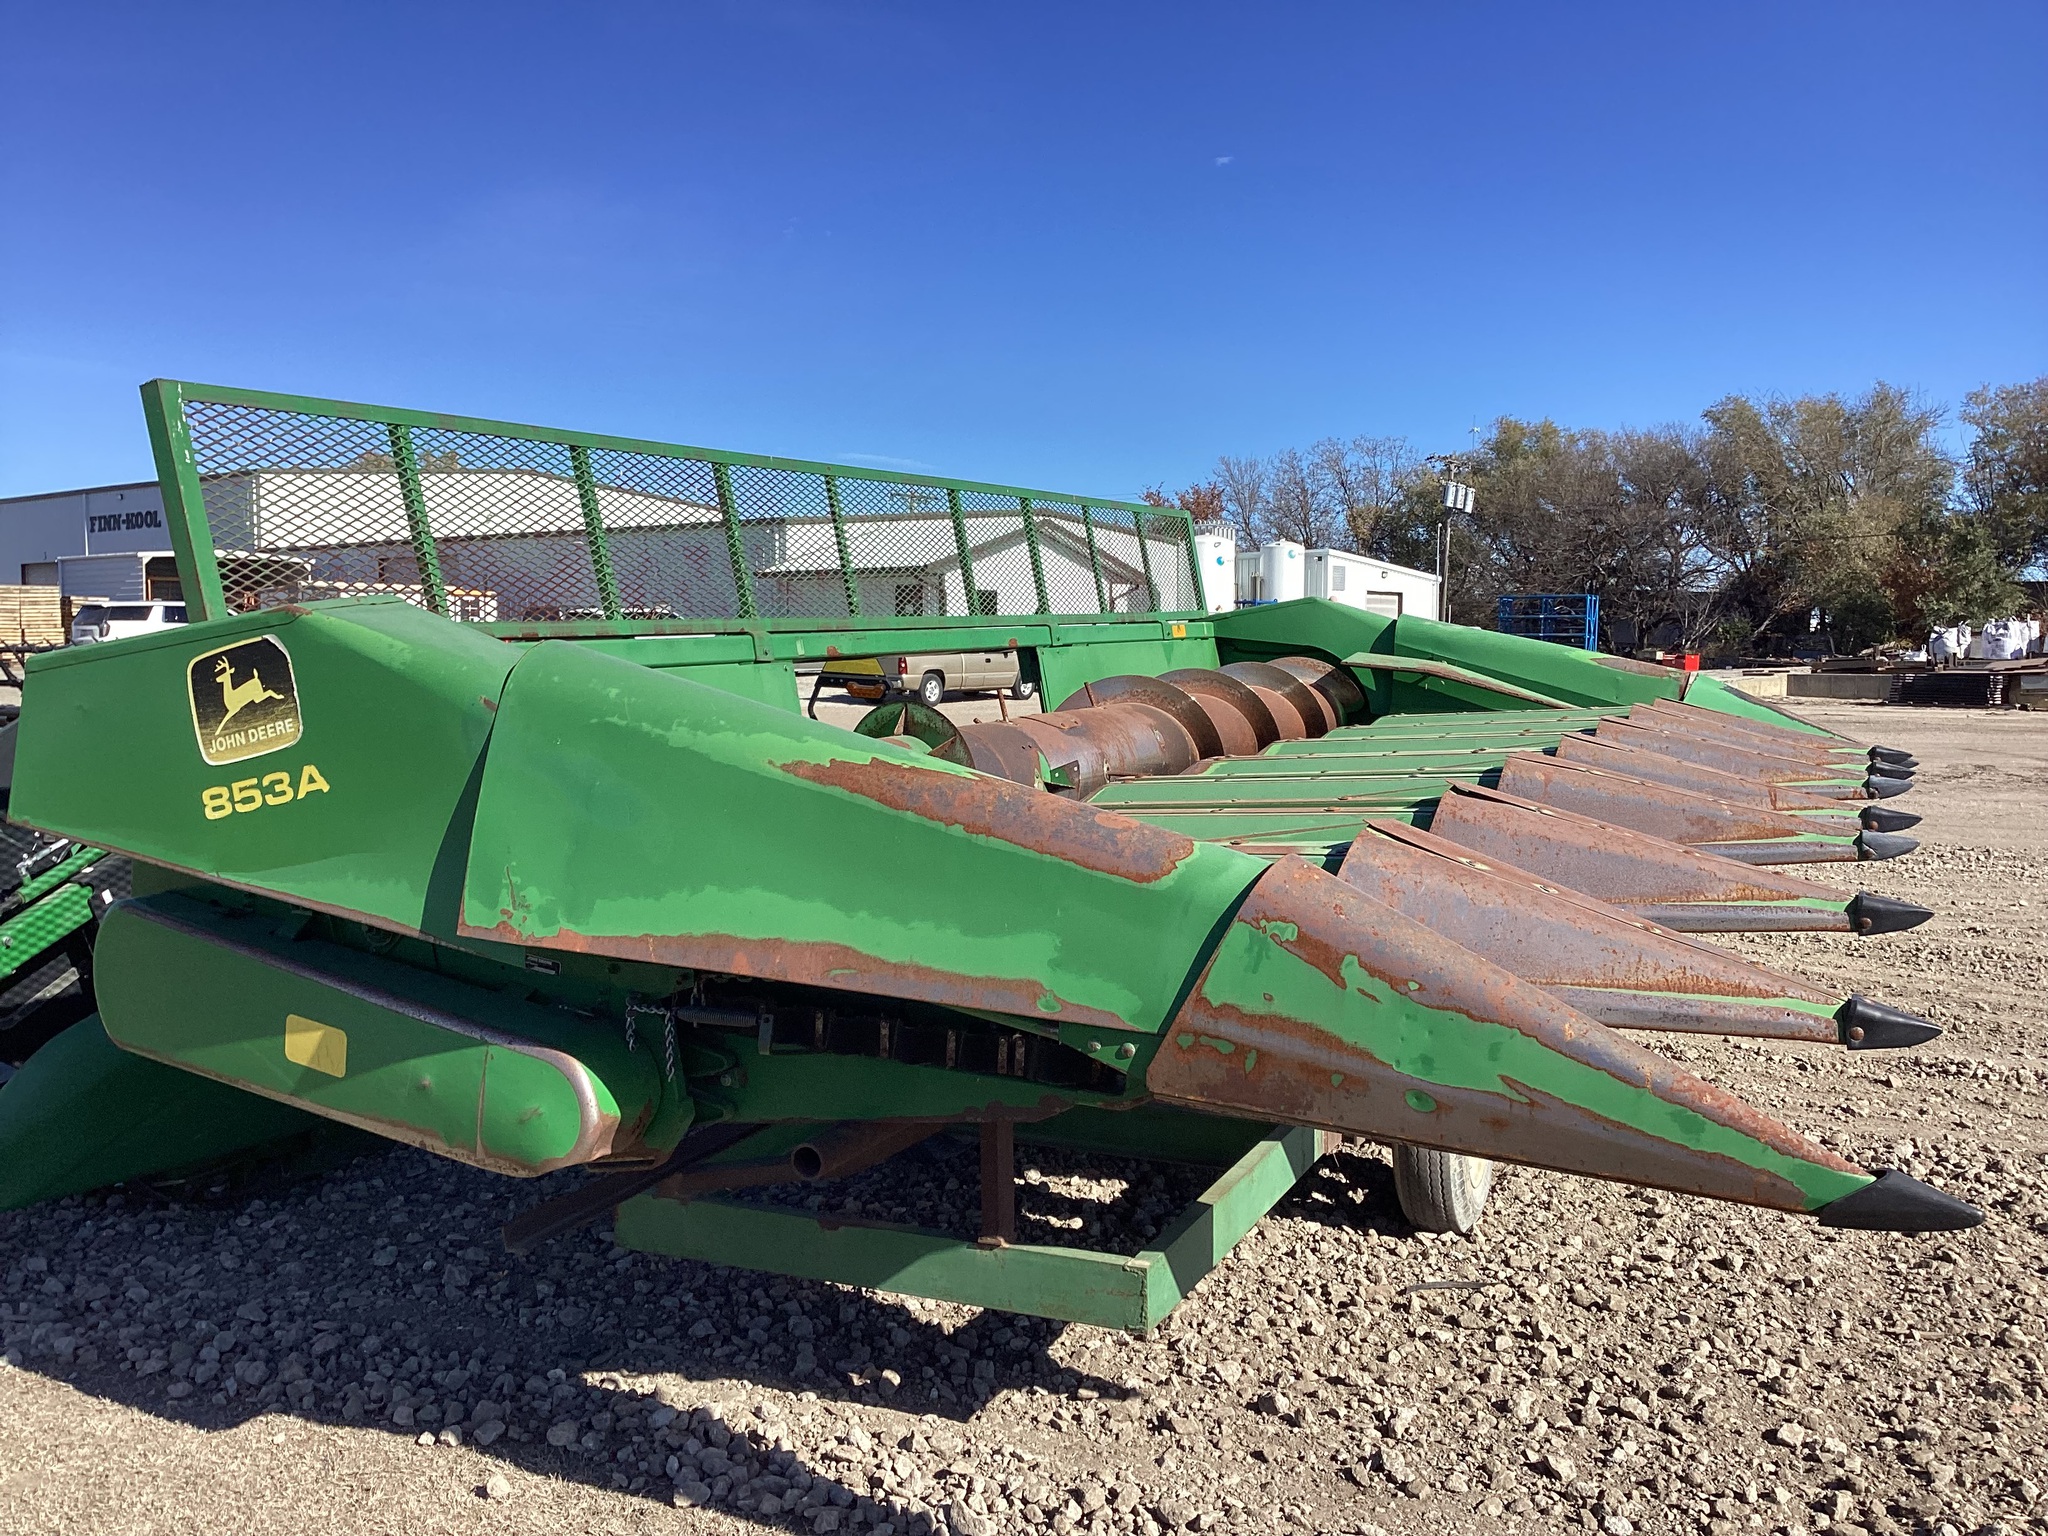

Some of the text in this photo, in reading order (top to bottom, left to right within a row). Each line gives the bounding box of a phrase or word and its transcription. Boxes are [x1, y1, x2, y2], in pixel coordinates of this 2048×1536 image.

[209, 718, 295, 754] JOHN DEERE
[202, 764, 331, 820] 853A
